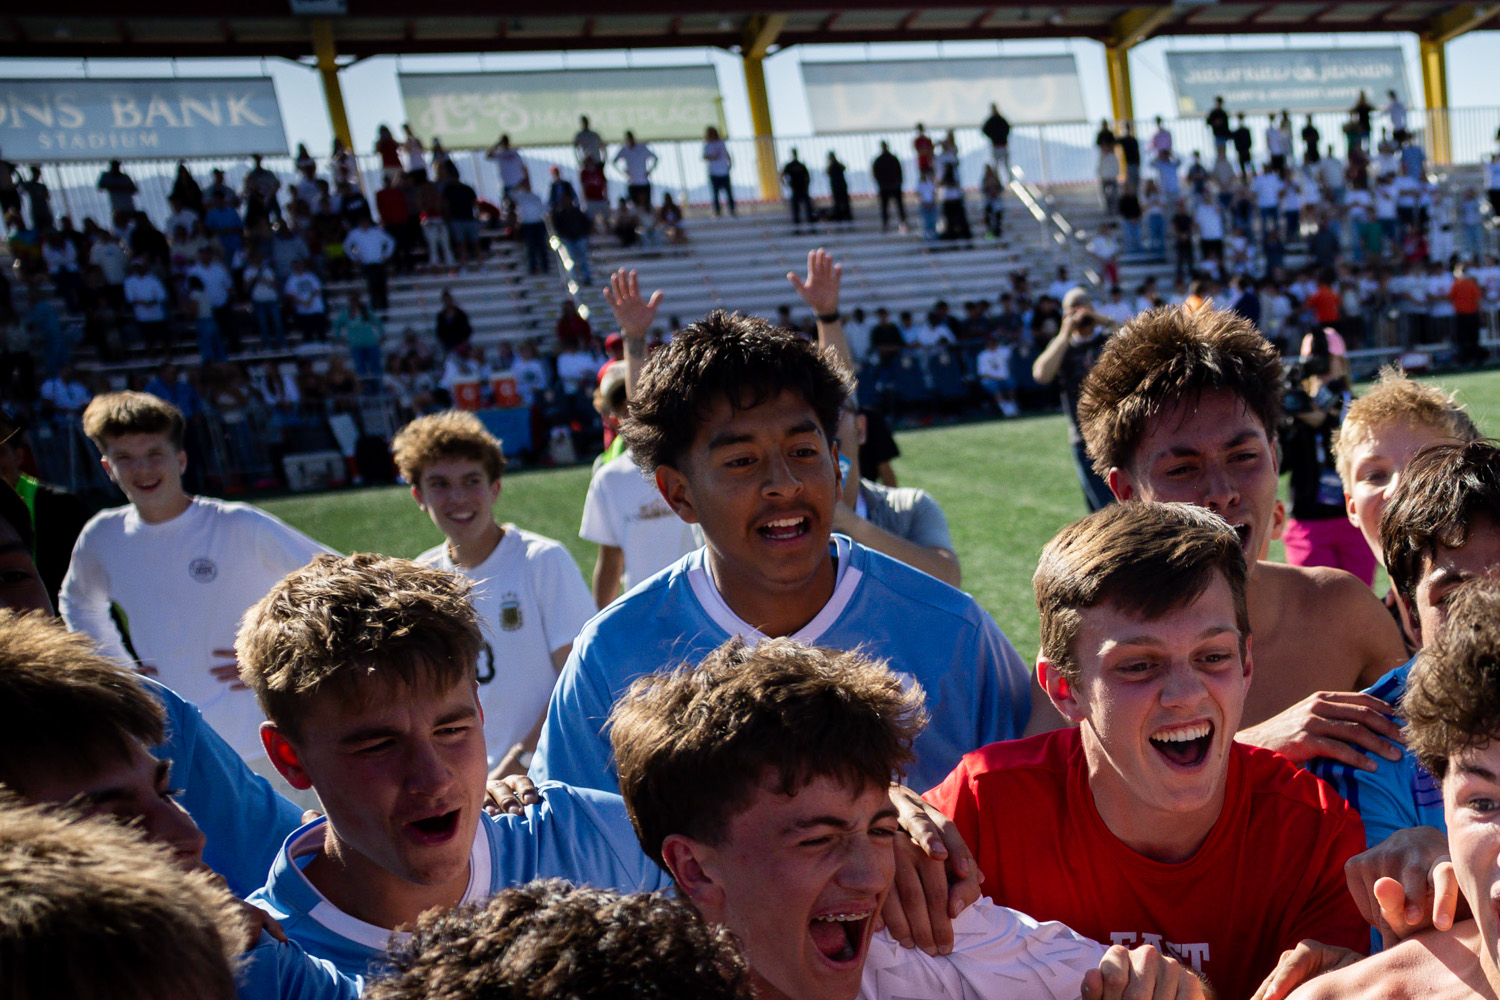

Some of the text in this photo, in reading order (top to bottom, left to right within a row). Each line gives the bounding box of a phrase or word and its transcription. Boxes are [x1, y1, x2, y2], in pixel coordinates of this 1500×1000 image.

[0, 91, 268, 129] NS BANK
[38, 131, 158, 149] STADIUM
